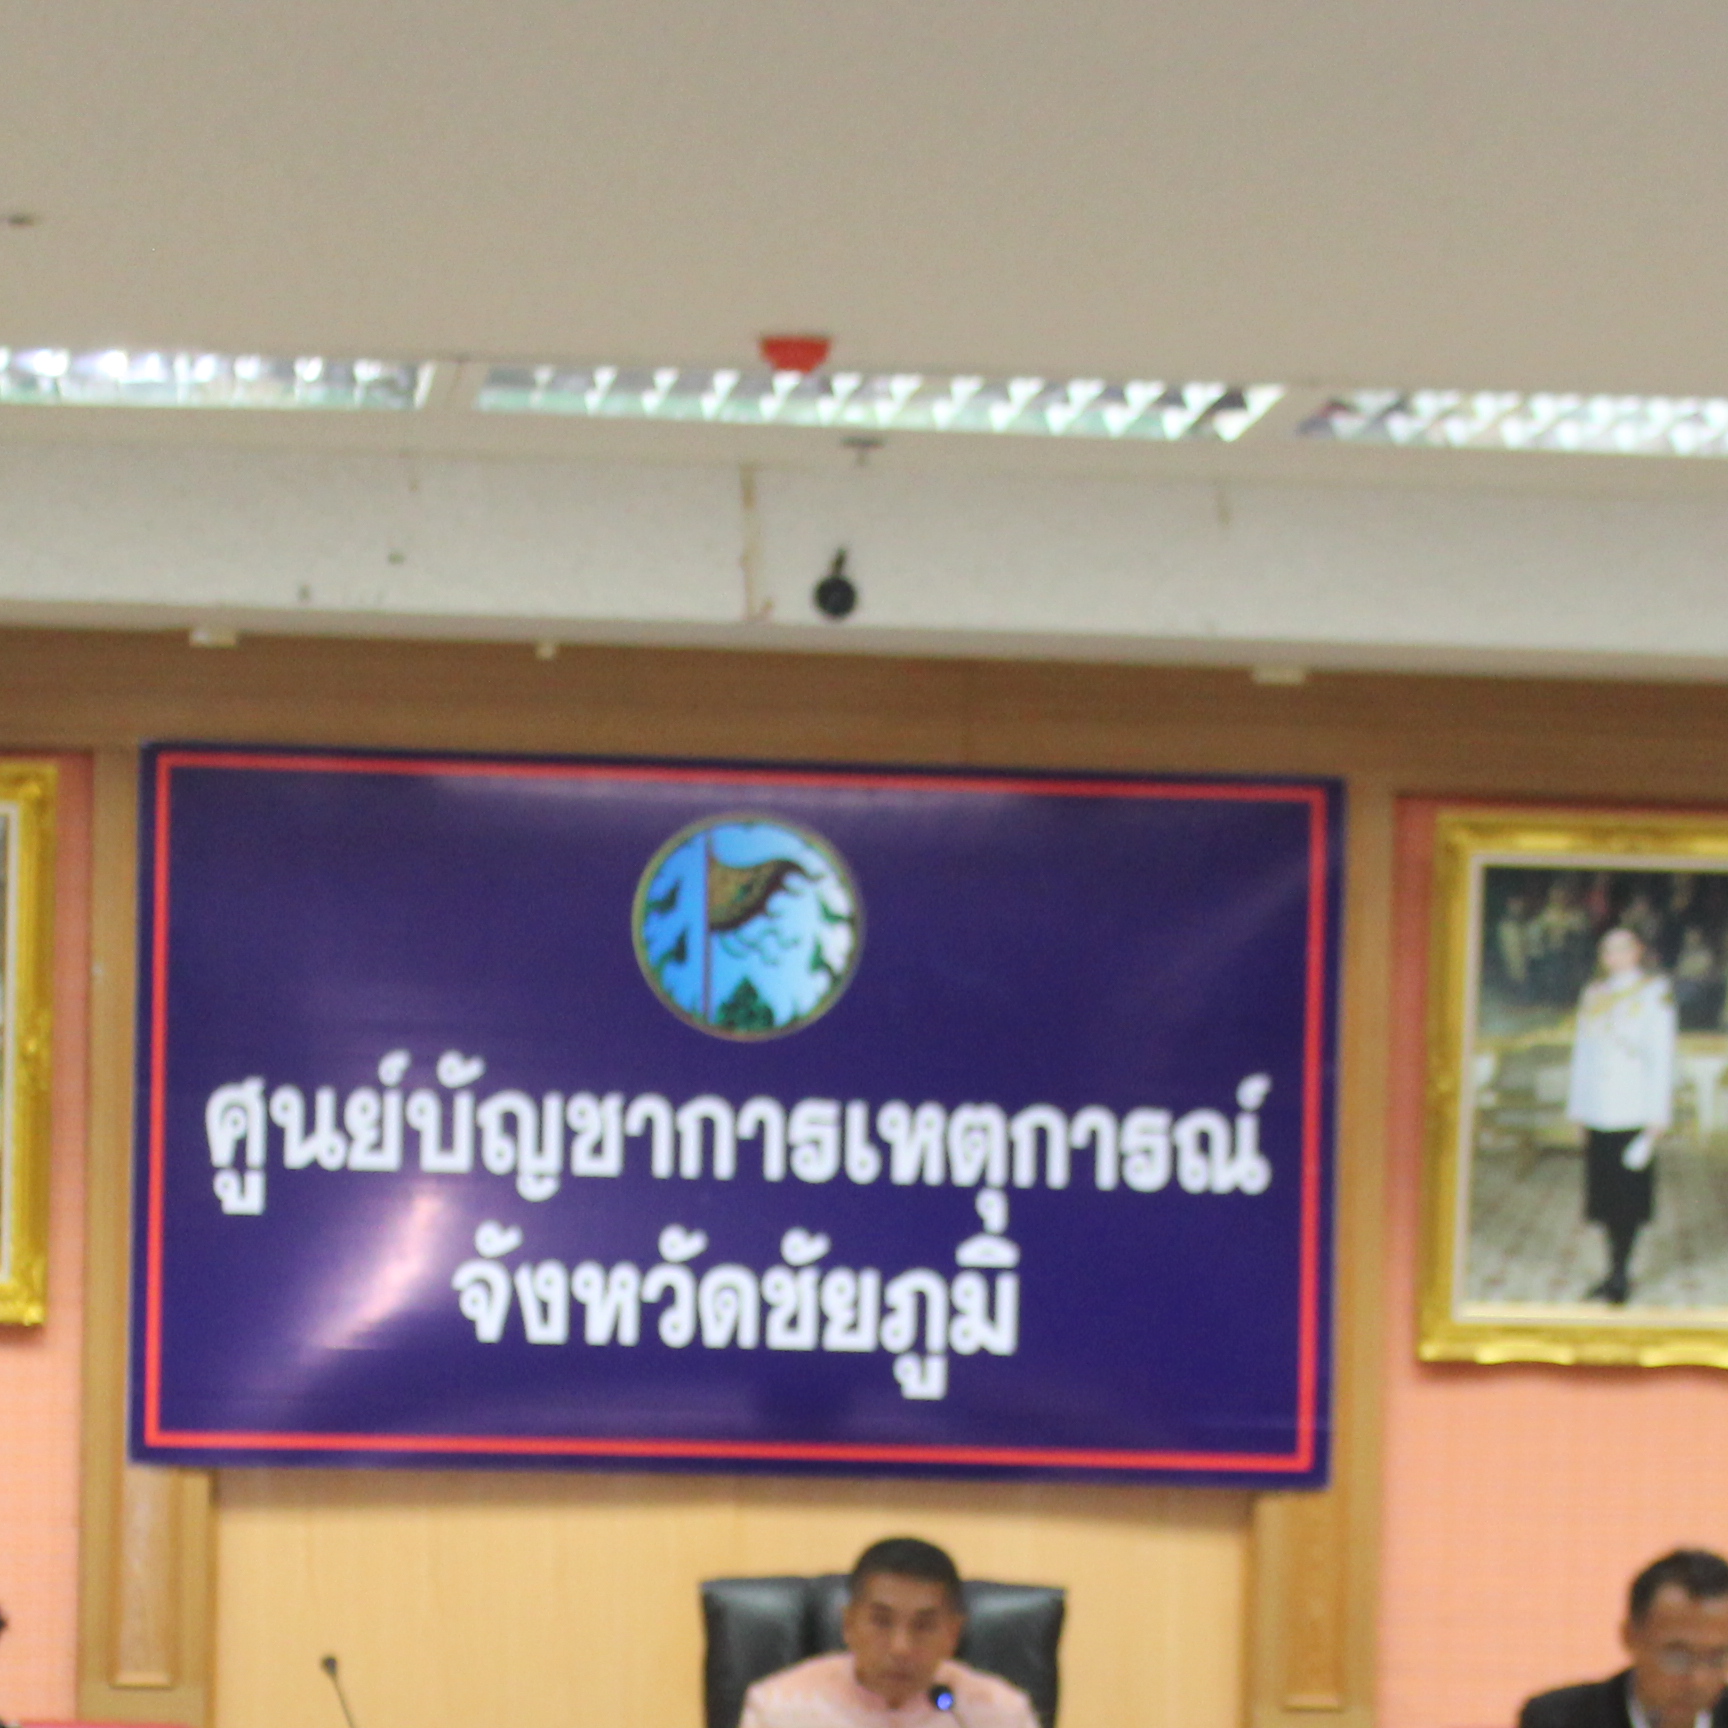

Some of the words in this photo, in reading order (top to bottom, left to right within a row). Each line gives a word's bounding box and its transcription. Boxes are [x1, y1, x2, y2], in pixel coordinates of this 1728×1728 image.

[204, 1050, 1270, 1233] ศูนย์บัญชาการเหตุการณ์
[451, 1219, 1020, 1400] จังหวัดชัยภูมิ
